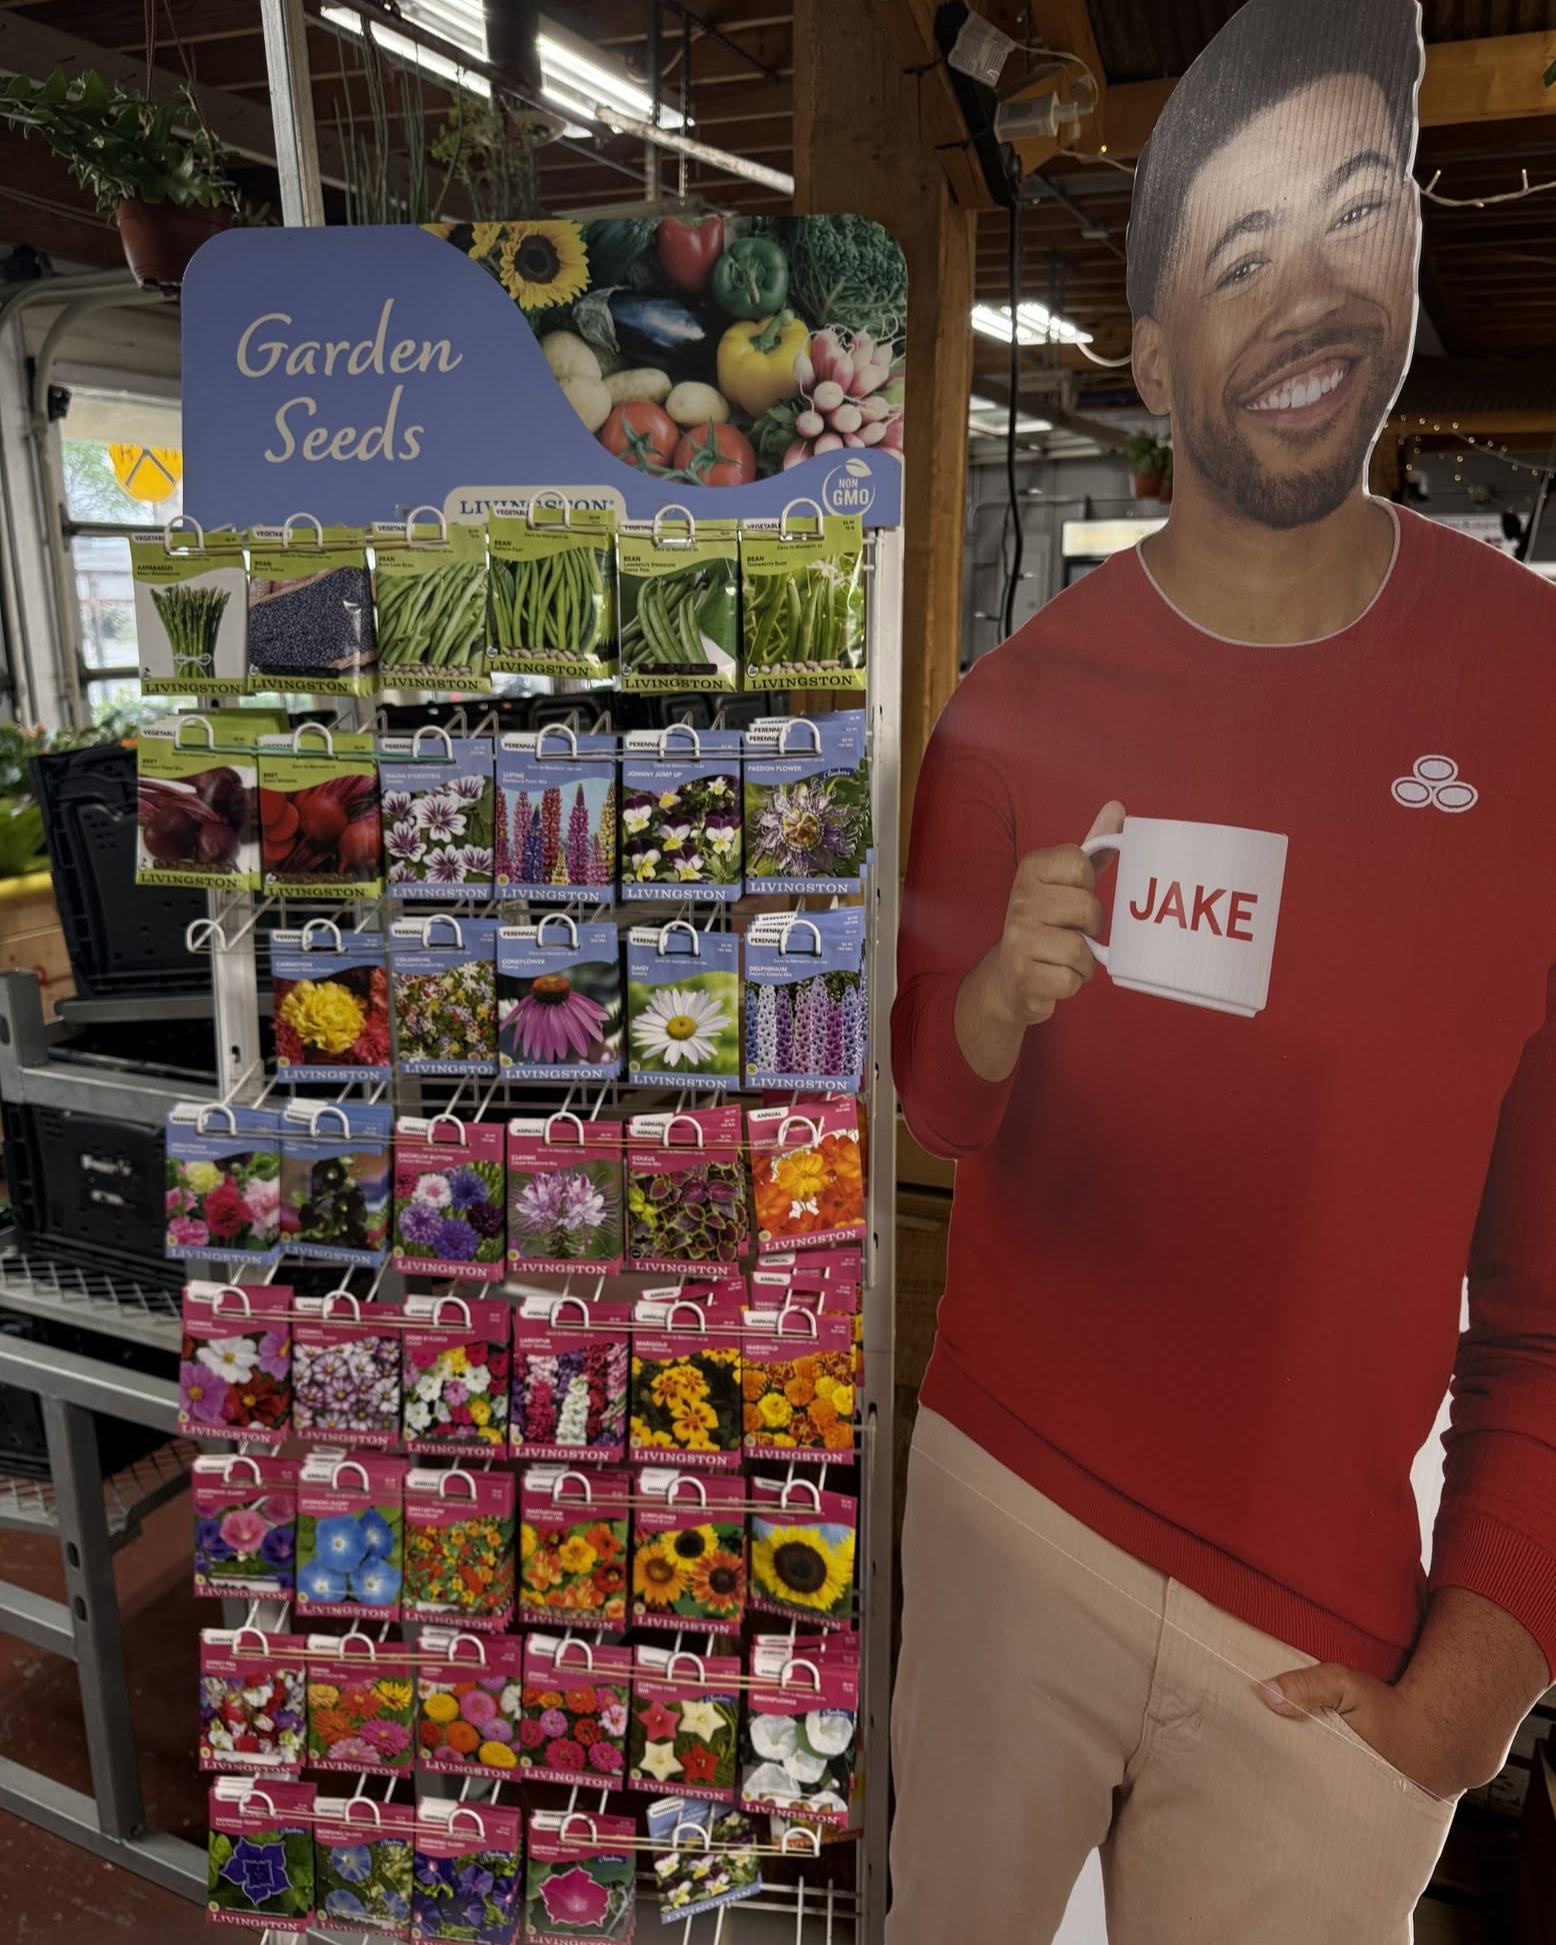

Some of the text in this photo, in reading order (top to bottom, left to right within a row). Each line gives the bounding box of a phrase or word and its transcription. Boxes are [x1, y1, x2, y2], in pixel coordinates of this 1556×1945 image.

[234, 298, 463, 379] Garden
[263, 385, 425, 464] Seeds
[838, 478, 859, 489] NON
[832, 488, 870, 506] GMO
[490, 661, 589, 676] LIVINGSTON
[146, 682, 241, 694] LIVINGSTON
[252, 678, 349, 692] LIVINGSTON
[384, 677, 479, 690] LIVINGSTON
[625, 679, 724, 690] LIVINGSTON
[752, 676, 853, 689] LIVINGSTON
[503, 741, 536, 749] PERENNIA
[141, 872, 238, 887] LIVINGSTON
[751, 880, 849, 893] LIVINGSTON
[269, 886, 365, 897] LIVINGSTON
[393, 887, 488, 898] LIVINGSTON
[502, 887, 600, 902] LIVINGSTON
[627, 887, 726, 900] LIVINGSTON
[1129, 875, 1260, 943] JAKE
[283, 1068, 380, 1079] LIVINGSTON
[506, 1068, 604, 1078] LIVINGSTON
[633, 1074, 727, 1087] LIVINGSTON
[751, 1076, 848, 1089] LIVINGSTON
[764, 1228, 857, 1251] LIVINGSTON
[172, 1247, 263, 1263] LIVINGSTON
[285, 1243, 372, 1263] LIVINGSTON
[397, 1259, 488, 1276] LIVINGSTON
[513, 1261, 607, 1273] LIVINGSTON
[635, 1261, 729, 1274] LIVINGSTON
[182, 1424, 271, 1442] LIVINGSTON
[297, 1429, 389, 1444] LIVINGSTON
[407, 1442, 496, 1456] LIVINGSTON
[515, 1446, 609, 1459] LIVINGSTON
[634, 1449, 727, 1464] LIVINGSTON
[749, 1448, 842, 1462] LIVINGSTON
[199, 1585, 289, 1600] LIVINGSTON
[302, 1603, 390, 1617] LIVINGSTON
[755, 1598, 841, 1630] LIVINGSTON
[405, 1610, 493, 1629] LIVINGSTON
[524, 1612, 614, 1630] LIVINGSTON
[637, 1614, 730, 1633] LIVINGSTON
[204, 1758, 292, 1773] LIVINGSTON
[312, 1759, 400, 1776] LIVINGSTON
[426, 1759, 511, 1778] LIVINGSTON
[525, 1768, 613, 1788] LIVINGSTON
[635, 1780, 724, 1800] LIVINGSTON
[745, 1802, 840, 1824] LIVINGSTON
[666, 1888, 752, 1922] LIVINGSTON
[211, 1913, 298, 1929] LIVINGSTON
